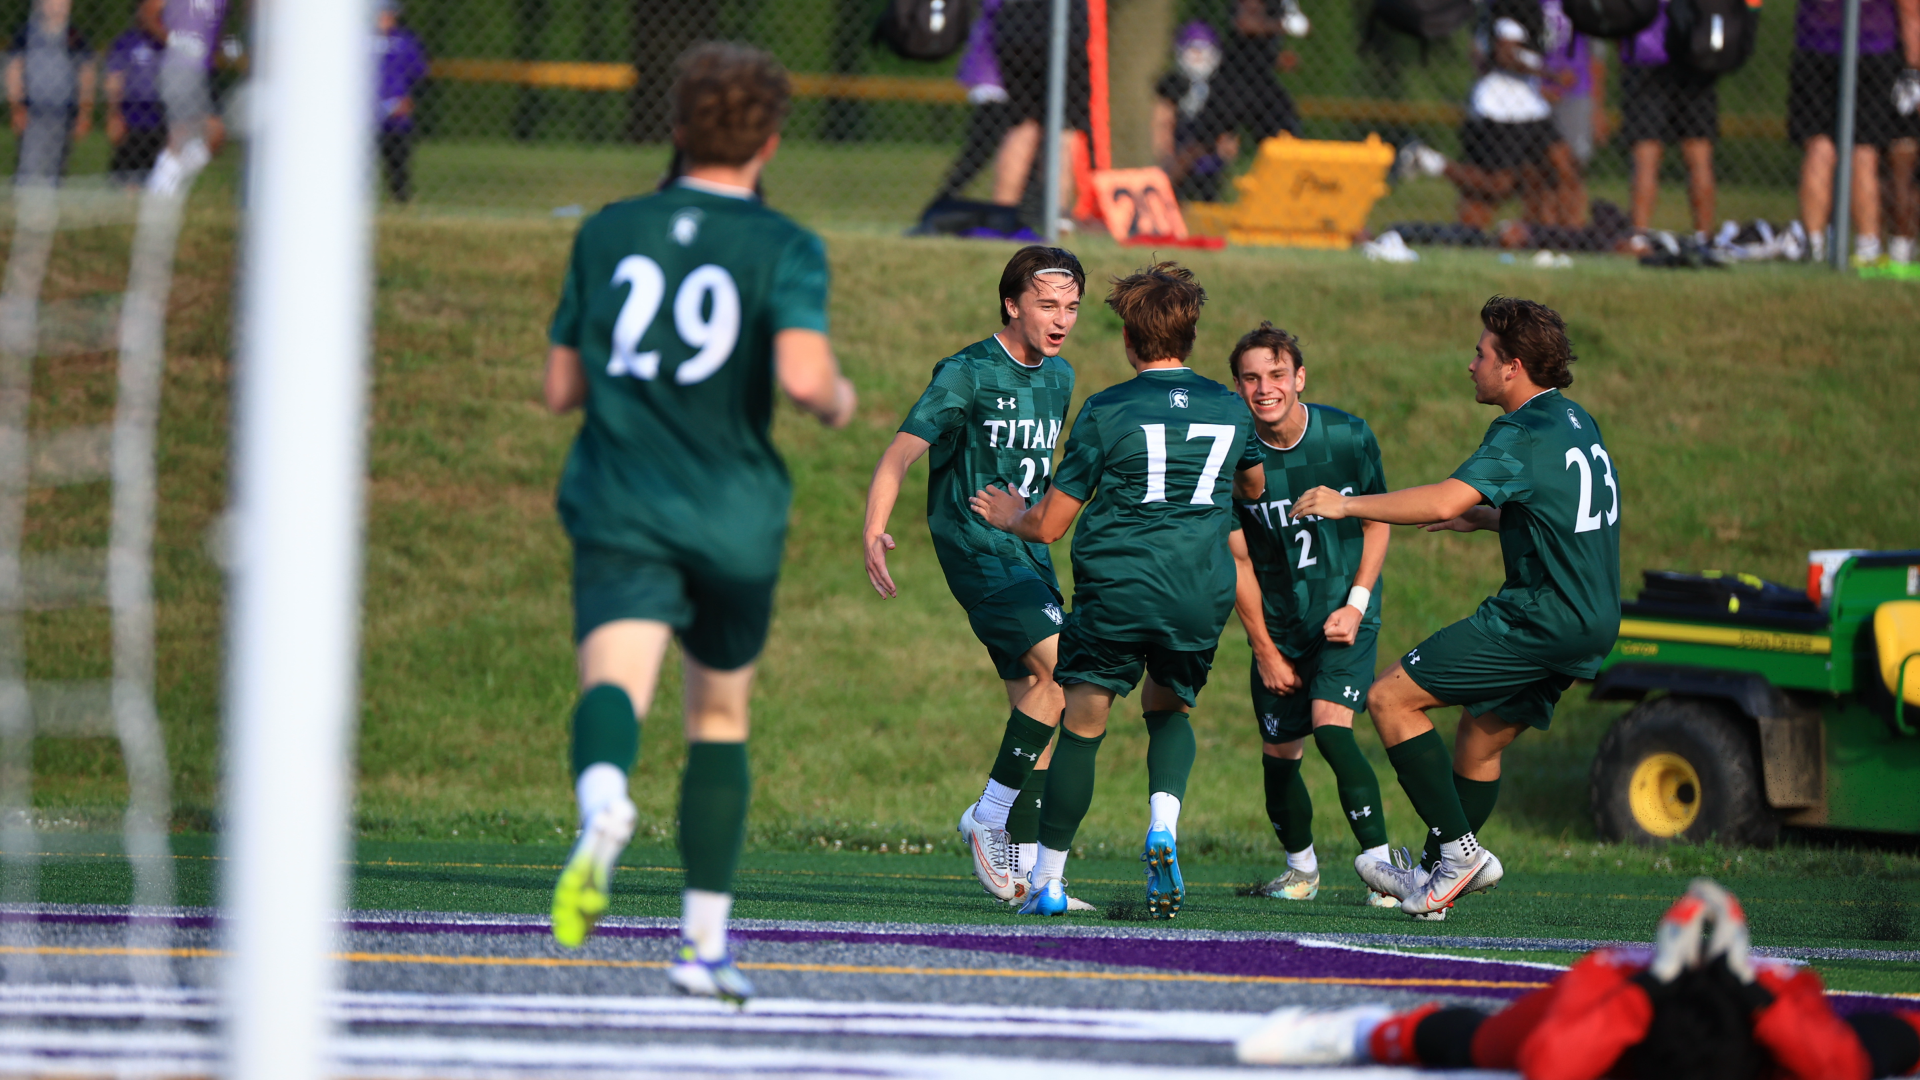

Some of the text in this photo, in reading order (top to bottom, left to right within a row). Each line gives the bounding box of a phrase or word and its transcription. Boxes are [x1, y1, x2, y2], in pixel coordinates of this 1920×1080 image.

[606, 254, 742, 385] 29
[1139, 423, 1236, 505] 17
[1565, 443, 1618, 533] 23
[1294, 529, 1317, 569] 2
